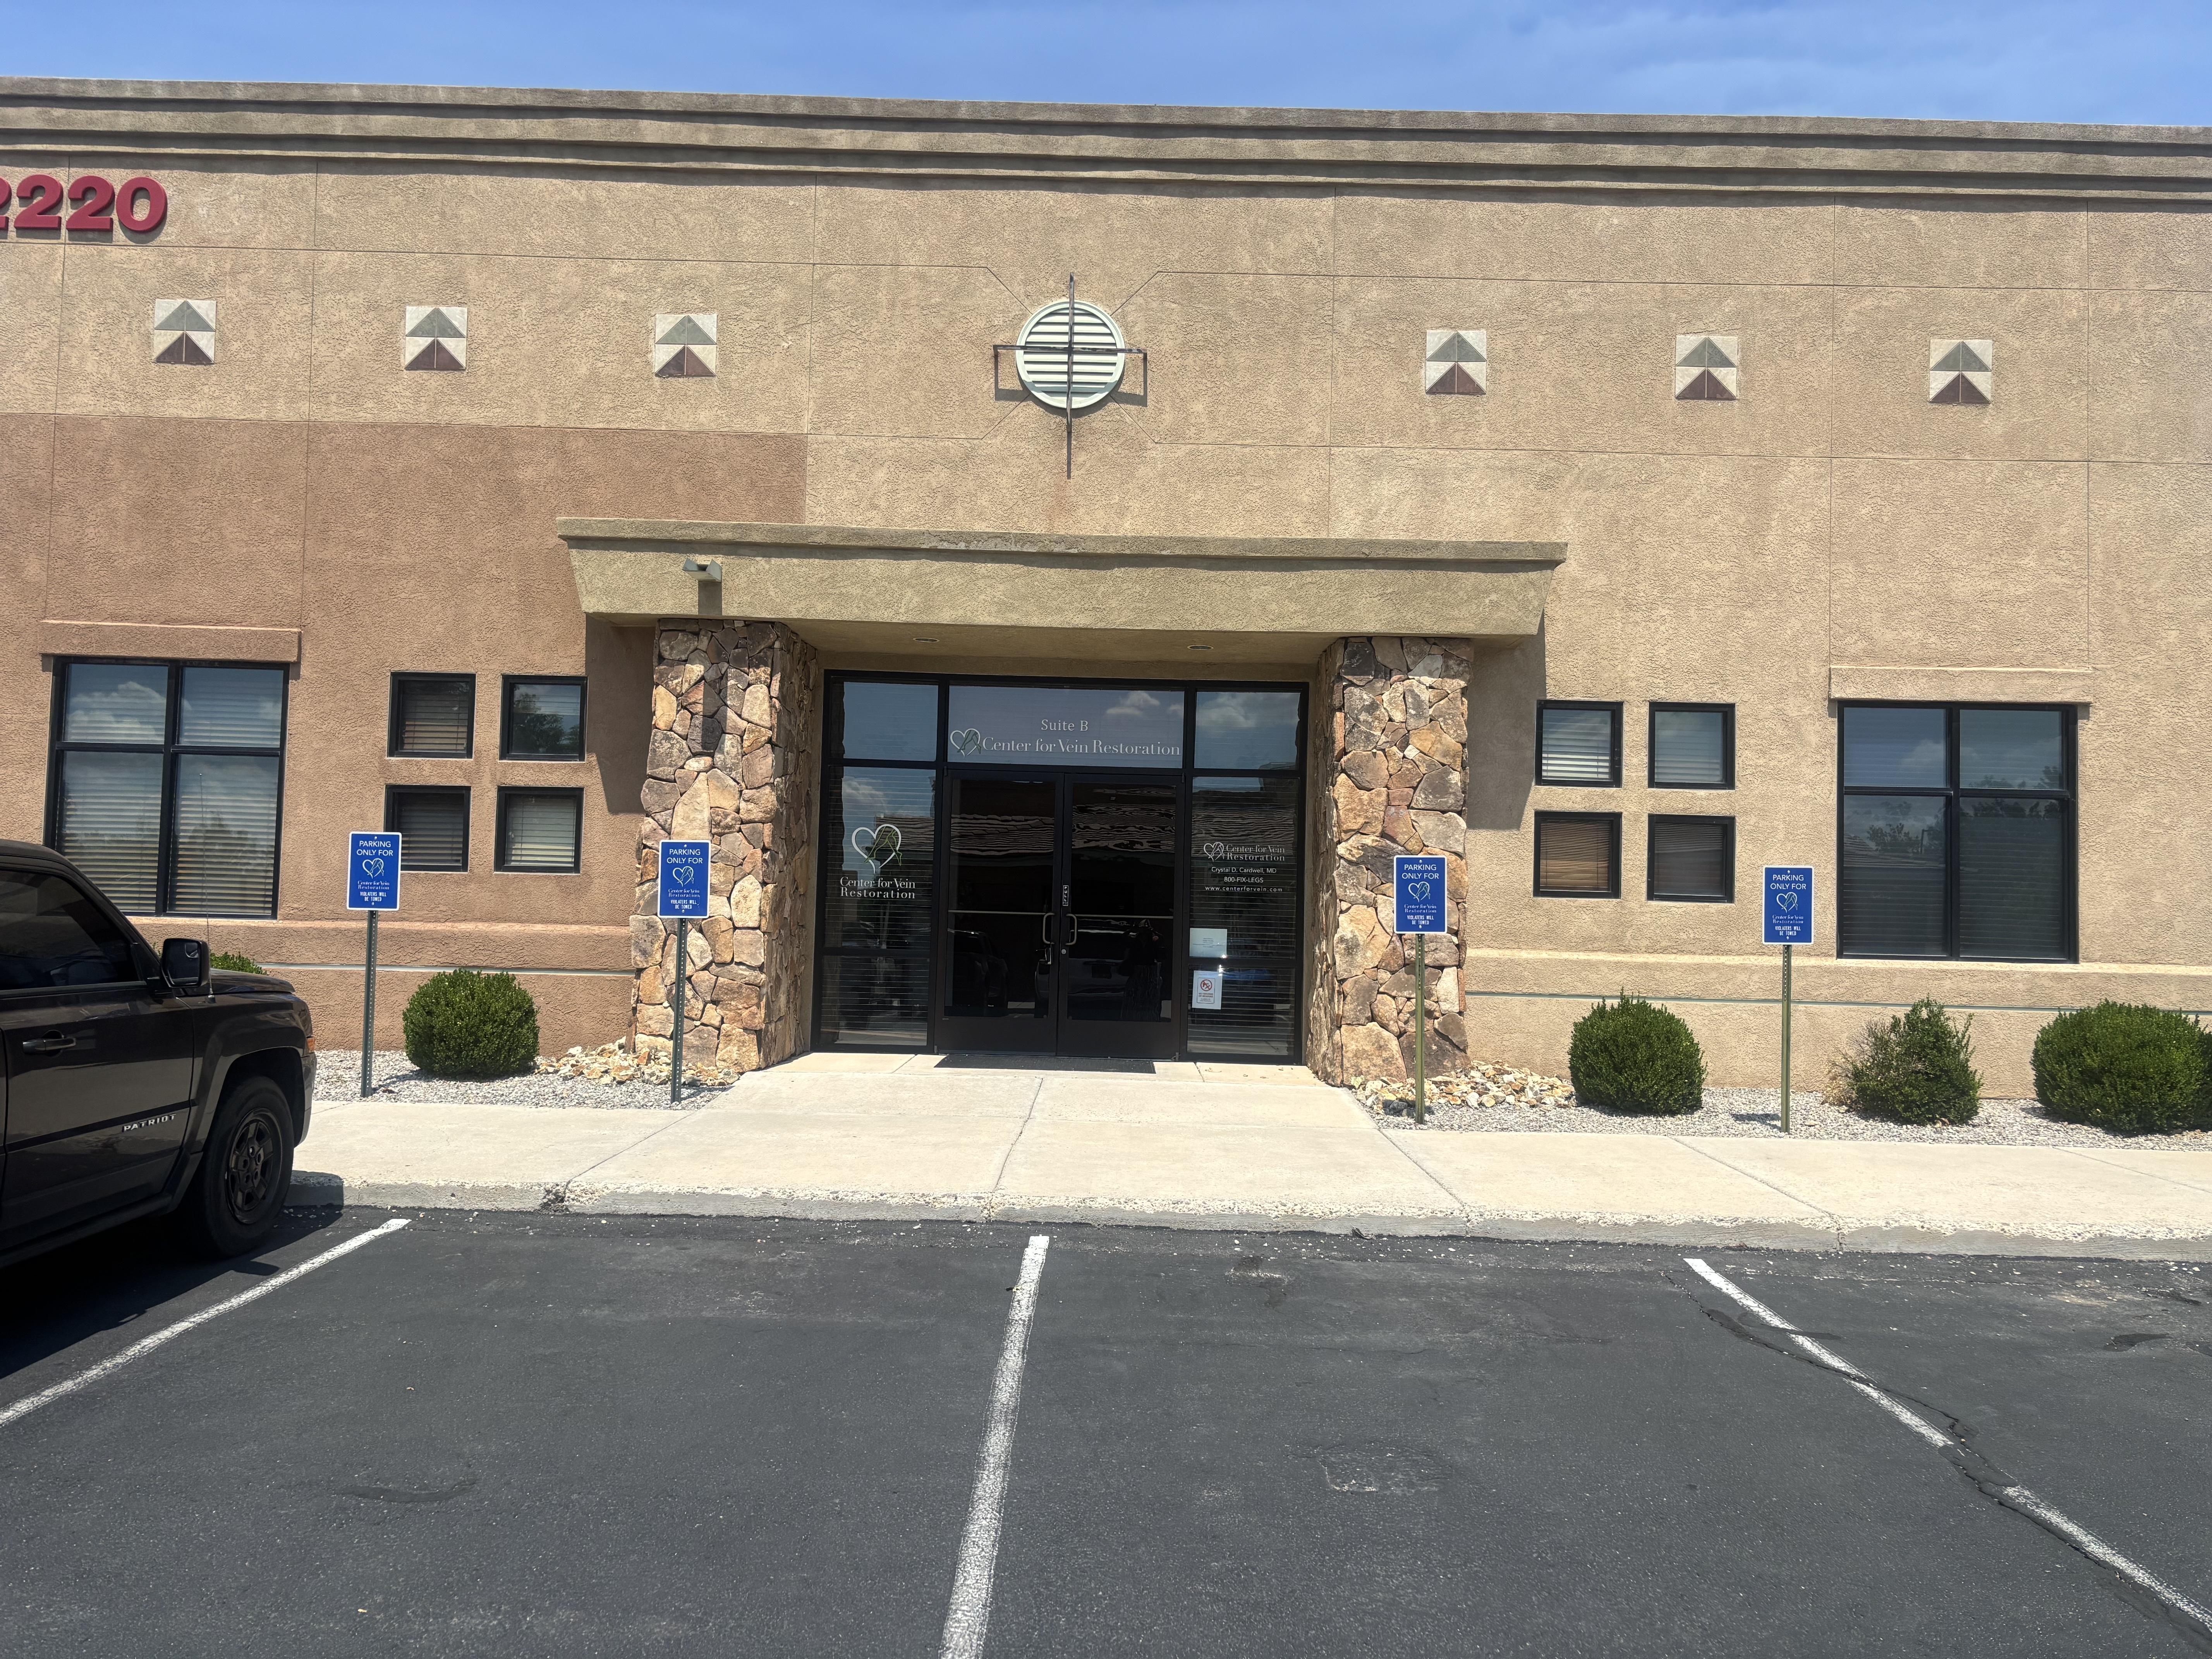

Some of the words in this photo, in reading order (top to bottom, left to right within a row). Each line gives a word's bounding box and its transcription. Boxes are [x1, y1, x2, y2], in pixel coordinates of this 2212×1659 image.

[0, 174, 167, 231] 220
[1041, 719, 1075, 731] Suite
[1080, 720, 1089, 731] B
[982, 737, 1031, 752] Center
[1036, 738, 1056, 752] for
[1057, 739, 1088, 753] Vein
[1093, 740, 1181, 756] Restoration
[1226, 844, 1254, 852] Center
[1255, 845, 1267, 853] for
[1268, 845, 1285, 853] Vein
[1227, 853, 1285, 861] Restoration
[840, 877, 875, 887] Center
[878, 878, 892, 887] for
[893, 878, 915, 888] Vein
[840, 887, 915, 899] Restoration
[123, 1114, 176, 1132] PATRIOT
